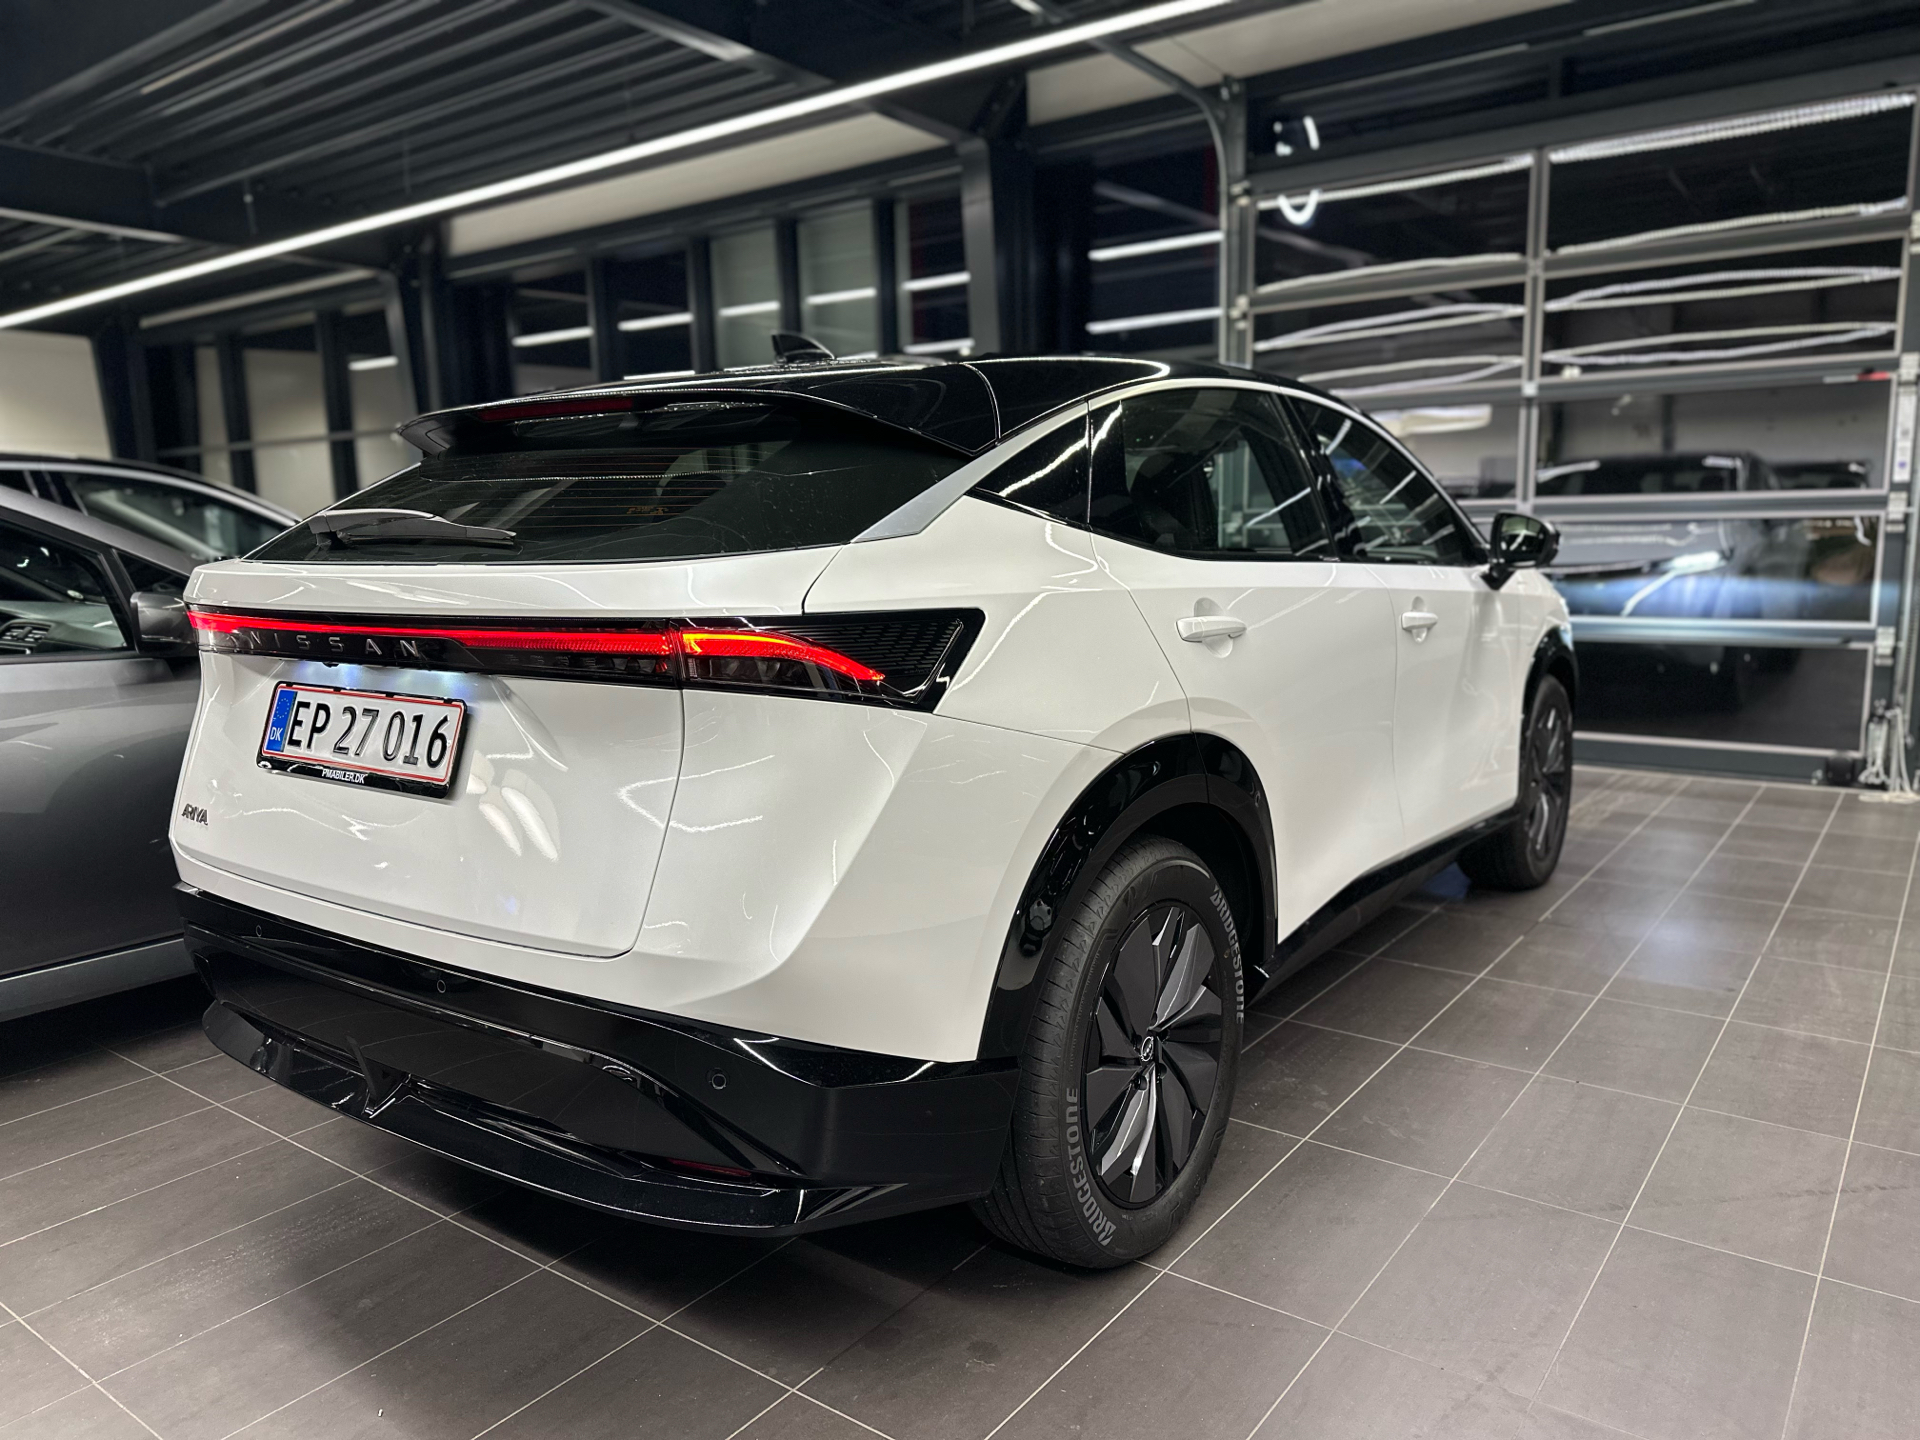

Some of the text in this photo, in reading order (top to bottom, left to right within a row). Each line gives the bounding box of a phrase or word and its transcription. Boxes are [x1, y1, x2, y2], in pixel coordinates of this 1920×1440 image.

[250, 630, 419, 658] NISSAN
[269, 727, 282, 741] DK
[287, 700, 450, 769] EP 27 016
[321, 768, 367, 784] PMABILER.DK
[181, 803, 209, 826] ARIYA
[1208, 884, 1244, 1025] BRIDGESTONE
[1065, 1086, 1117, 1248] BRIDGESTONE
